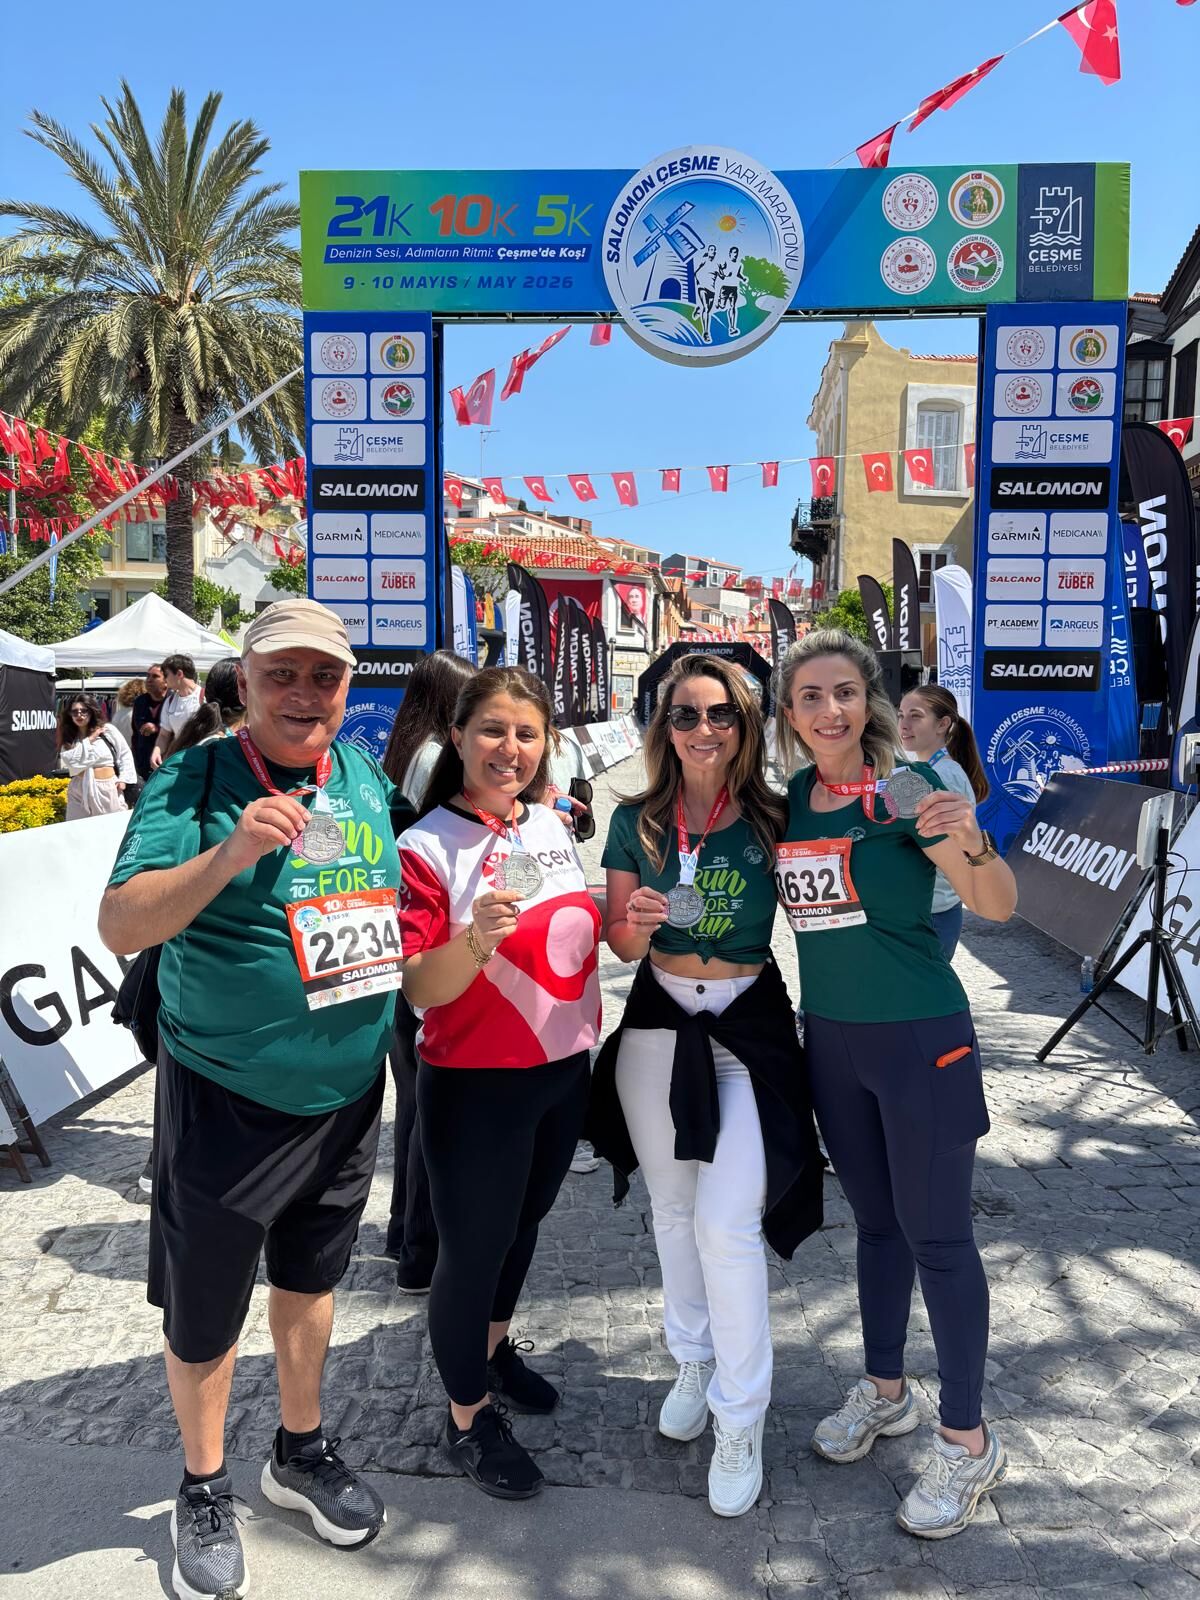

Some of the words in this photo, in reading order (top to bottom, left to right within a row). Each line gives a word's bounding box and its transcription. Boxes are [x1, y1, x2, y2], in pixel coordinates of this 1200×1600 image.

[327, 195, 415, 237] 21K
[429, 194, 519, 237] 10K
[533, 194, 594, 237] 5K
[607, 175, 655, 264] SALOMON
[656, 155, 720, 185] ÇEŞME
[329, 247, 372, 259] Denizin
[375, 247, 401, 259] Sesi,
[405, 247, 459, 259] Adımların
[462, 247, 494, 259] Ritmi:
[497, 247, 556, 261] Çeşme'de
[559, 247, 586, 260] Koş!
[1028, 248, 1082, 264] ÇEŞME
[1028, 263, 1082, 273] BELEDİYESİ
[343, 277, 355, 289] 9
[372, 277, 394, 289] 10
[401, 276, 458, 289] MAYIS
[464, 276, 471, 289] /
[477, 277, 517, 289] MAY
[523, 276, 573, 289] 2026
[366, 436, 404, 447] ÇEŞME
[1049, 433, 1089, 443] ÇEŞME
[319, 483, 418, 497] SALOMON
[997, 481, 1103, 496] SALOMON
[315, 532, 363, 541] GARMIN
[374, 530, 418, 538] MEDICANA
[991, 532, 1041, 541] GARMIN
[1052, 529, 1098, 538] MEDICANA
[315, 575, 365, 583] SALCANO
[381, 575, 416, 589] ZÜBER
[989, 575, 1041, 583] SALCANO
[1058, 575, 1094, 589] ZÜBER
[389, 619, 422, 629] ARGEUS
[1064, 620, 1099, 629] ARGEUS
[990, 663, 1095, 678] SALOMON
[987, 717, 1012, 763] SALOMON
[329, 797, 352, 810] 21K
[712, 855, 729, 864] 21K
[1022, 821, 1138, 892] SALOMON
[289, 884, 317, 899] 10K
[318, 867, 370, 898] FOR
[372, 874, 387, 888] 5K
[323, 899, 347, 913] 10K
[704, 897, 729, 912] OR
[730, 902, 743, 910] 5K
[309, 919, 400, 973] 2234
[342, 961, 398, 982] SALOMON
